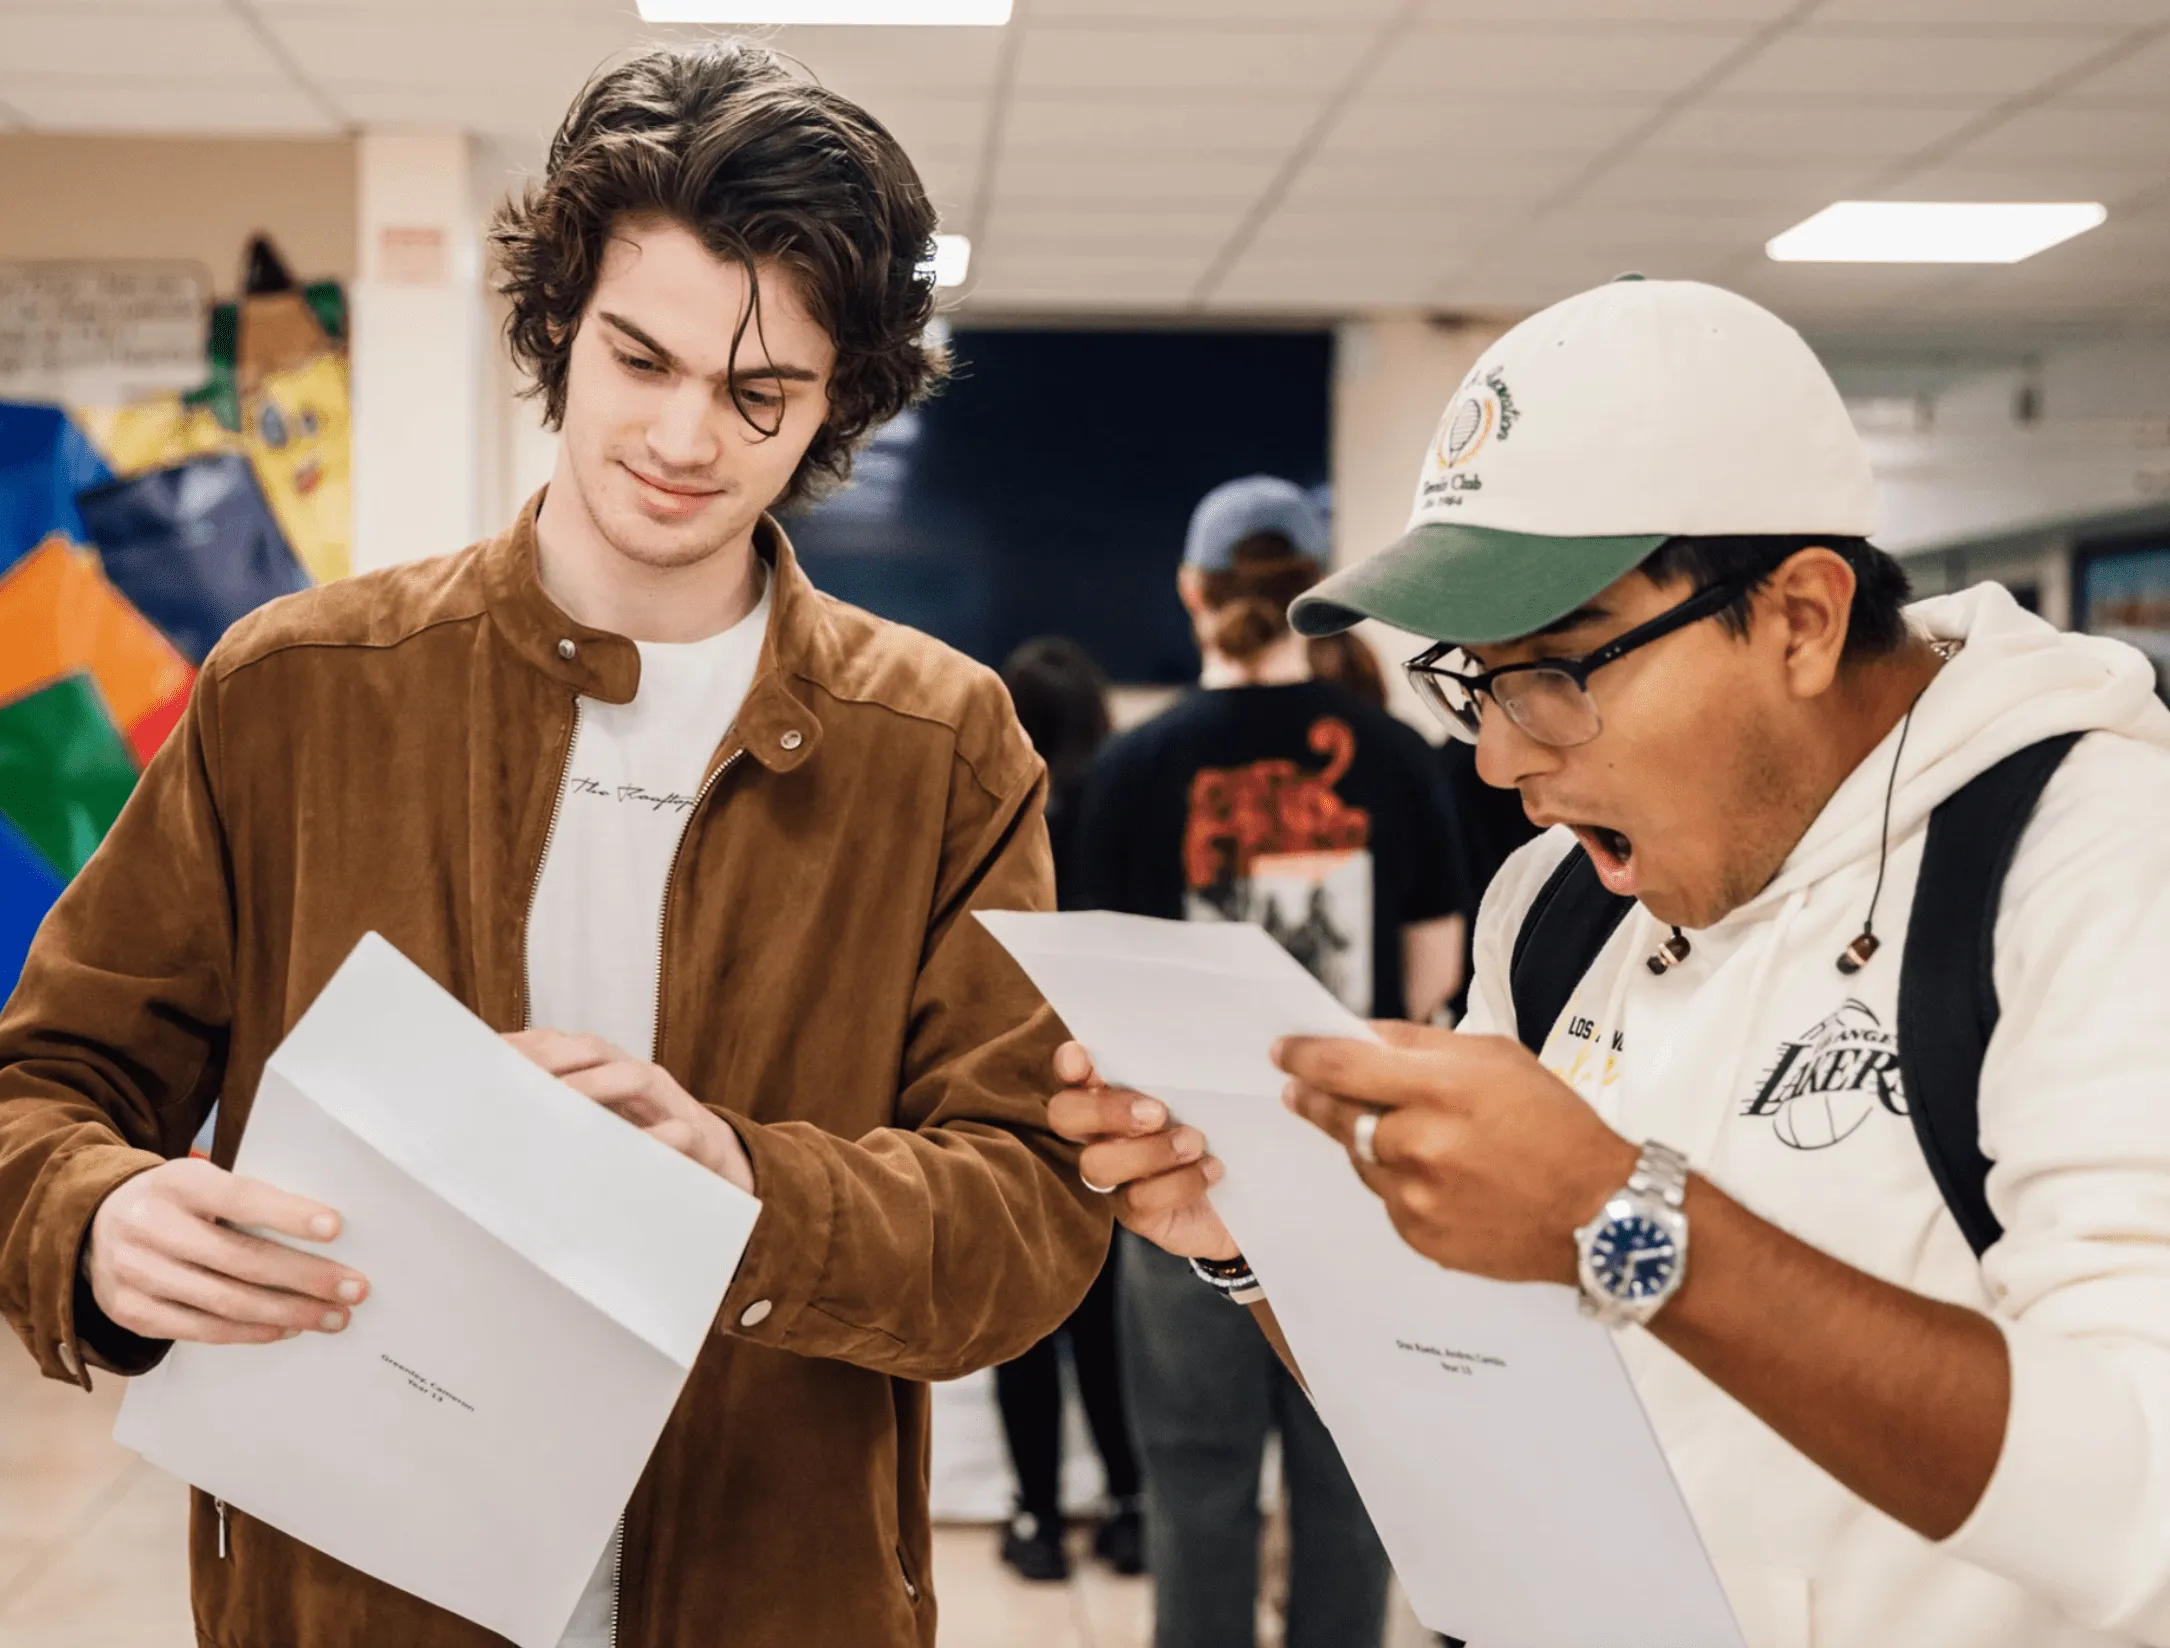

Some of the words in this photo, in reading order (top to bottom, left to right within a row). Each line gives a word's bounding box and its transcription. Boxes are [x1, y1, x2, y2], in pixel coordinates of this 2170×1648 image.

[1451, 473, 1482, 490] Club
[1568, 1016, 1594, 1040] LOS
[1739, 1041, 1911, 1116] LAKER
